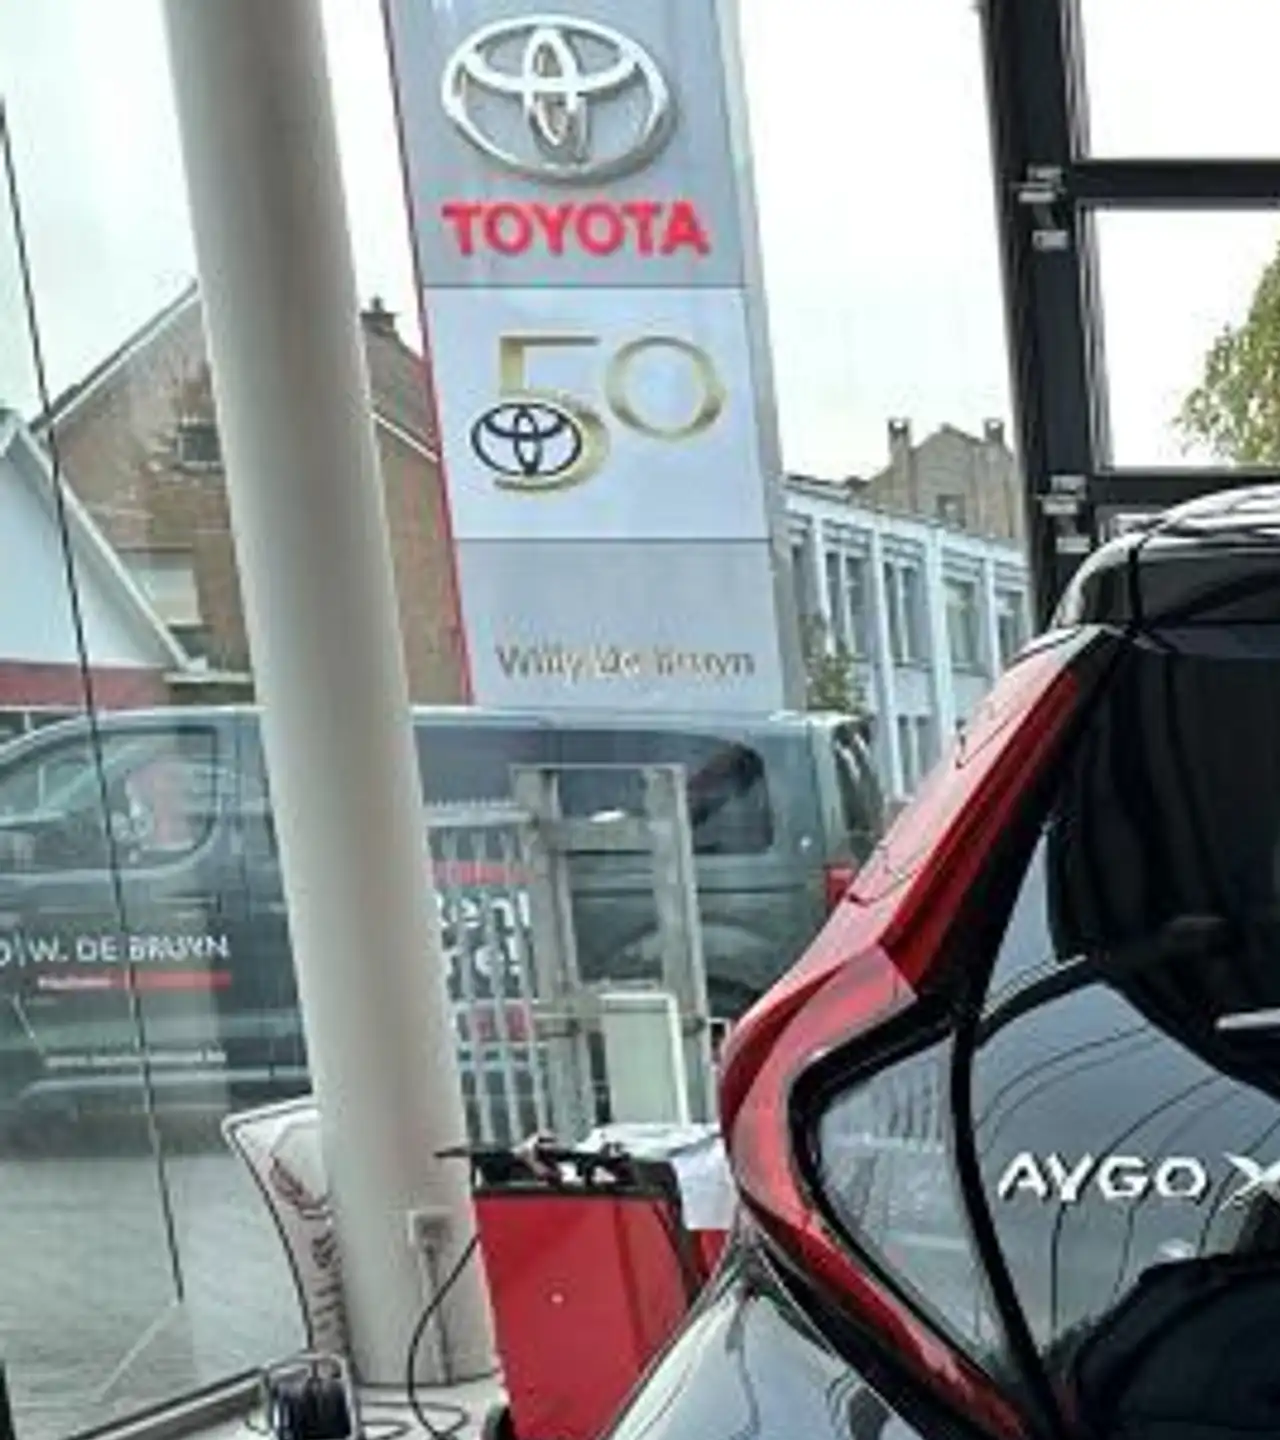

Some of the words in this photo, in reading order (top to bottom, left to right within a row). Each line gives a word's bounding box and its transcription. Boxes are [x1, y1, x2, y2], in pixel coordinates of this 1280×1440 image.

[442, 200, 712, 258] TOYOTA
[75, 934, 118, 963] DE
[997, 1151, 1208, 1202] AYGO
